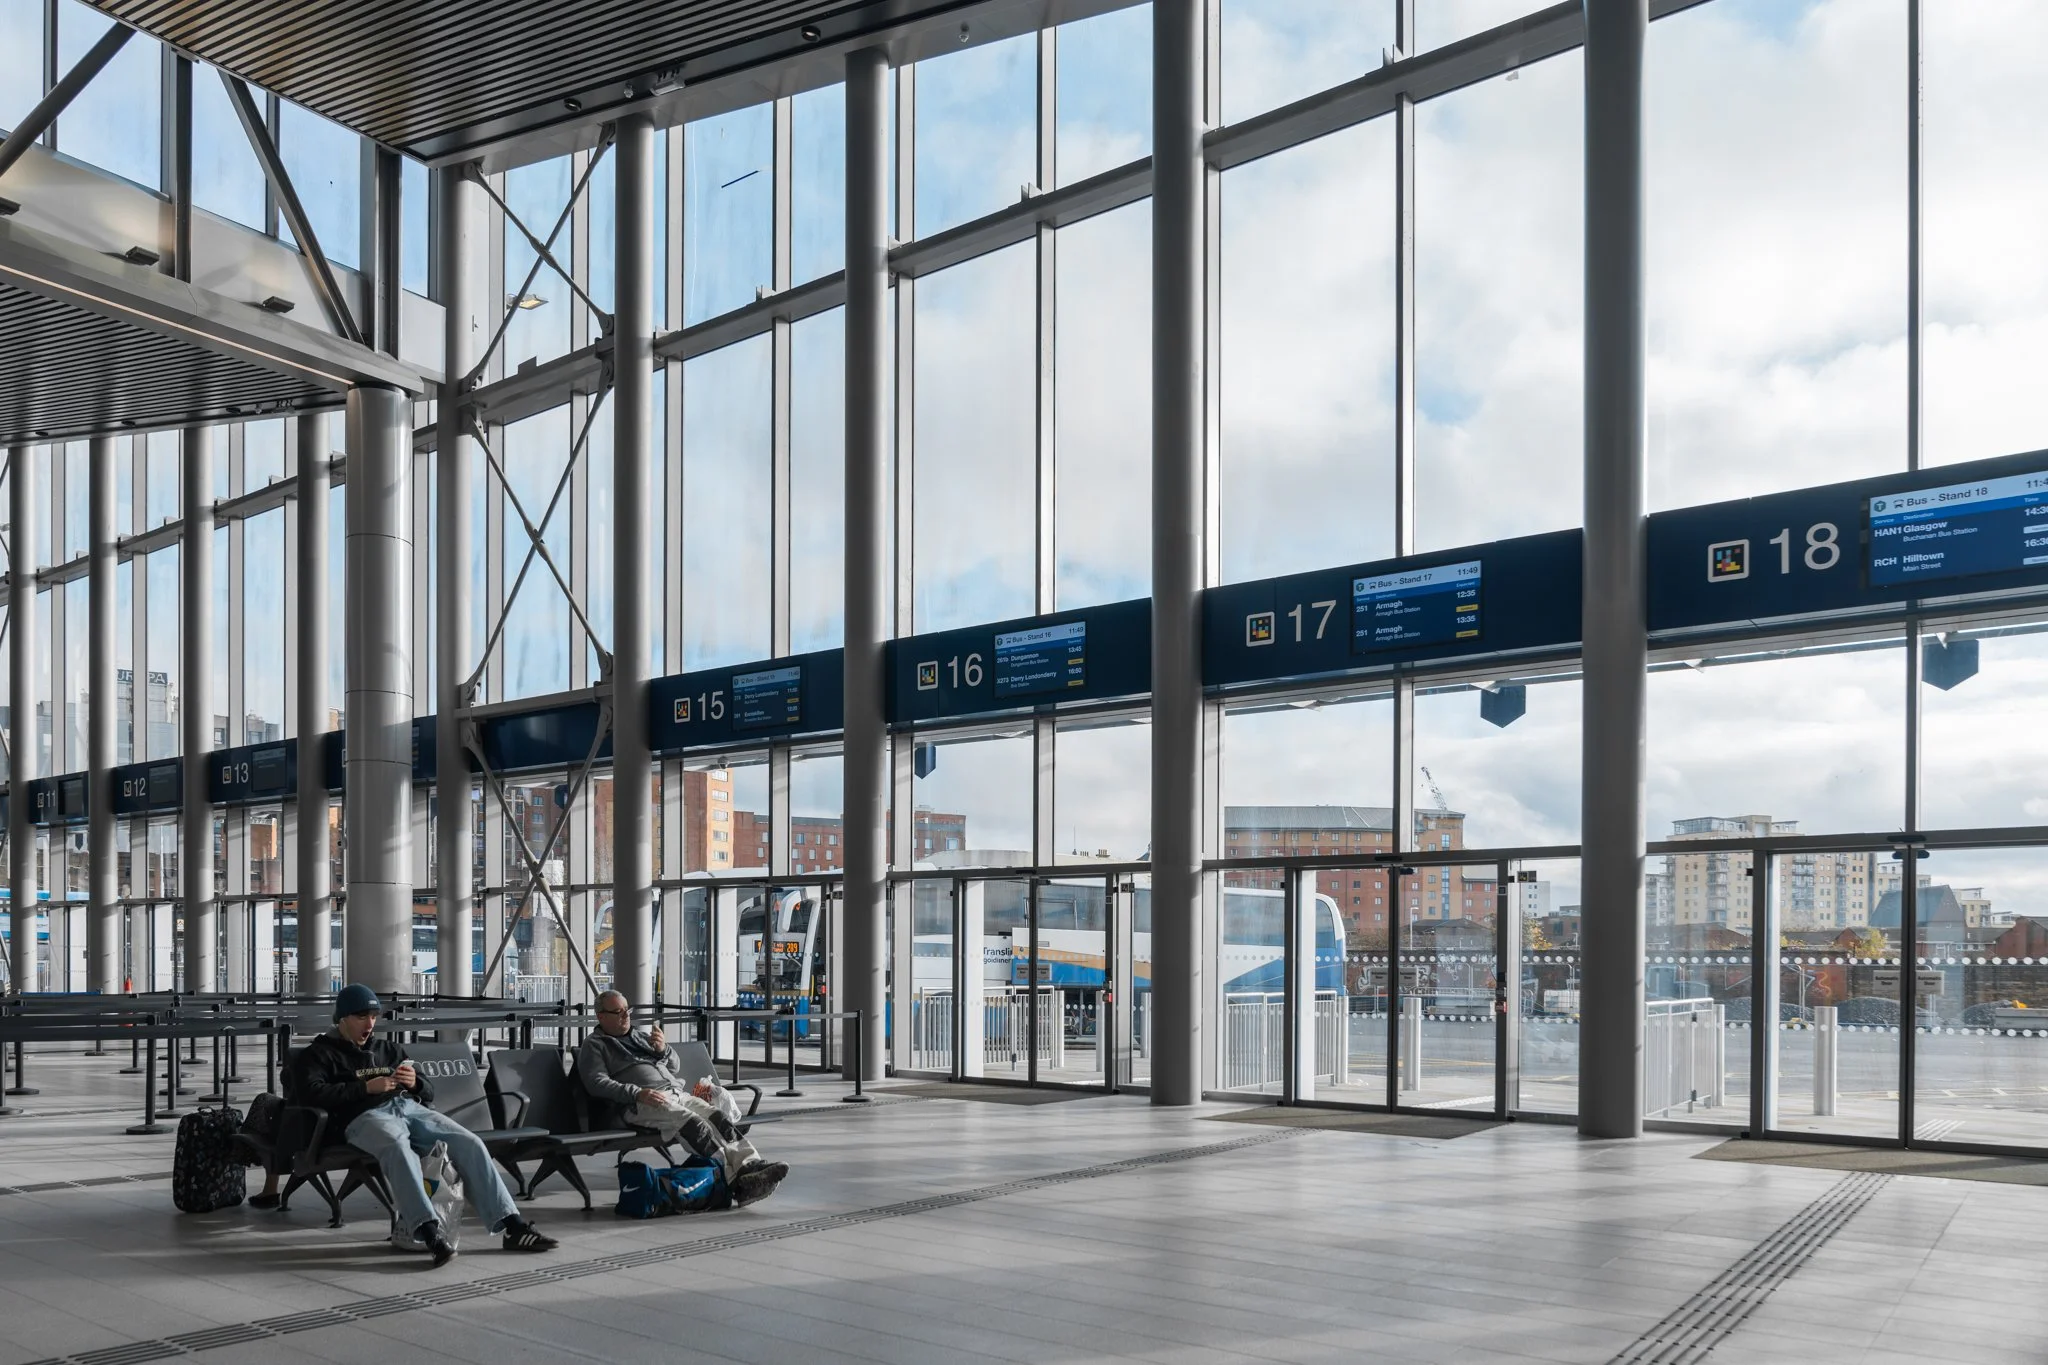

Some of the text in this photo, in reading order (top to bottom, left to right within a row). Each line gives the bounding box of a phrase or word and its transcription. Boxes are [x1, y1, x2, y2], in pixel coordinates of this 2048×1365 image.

[2026, 478, 2048, 488] 11:4
[1907, 495, 1927, 506] Bus
[1938, 490, 1971, 501] Stand
[1976, 487, 1988, 496] 18
[1903, 512, 1934, 521] Destination
[1874, 521, 1948, 538] HAN1 Glasgow
[1903, 526, 1978, 543] Buchanan Bus Station
[1769, 522, 1841, 574] 18
[1874, 551, 1944, 567] RCH Hilltown
[1903, 561, 1941, 572] Main Street
[1457, 566, 1478, 576] 11:49
[1378, 580, 1392, 588] Bus
[1399, 576, 1421, 585] Stand
[1424, 573, 1432, 581] 17
[1456, 590, 1476, 599] 12:35
[1356, 600, 1403, 613] 251 Armagh
[1288, 600, 1336, 642] 17
[1027, 632, 1043, 640] Stand
[1069, 626, 1083, 634] 11:49
[1356, 625, 1403, 638] 251 Armagh
[947, 653, 983, 688] 16
[698, 690, 724, 721] 15
[234, 762, 249, 783] 13
[134, 777, 146, 797] 12
[46, 789, 55, 808] 11
